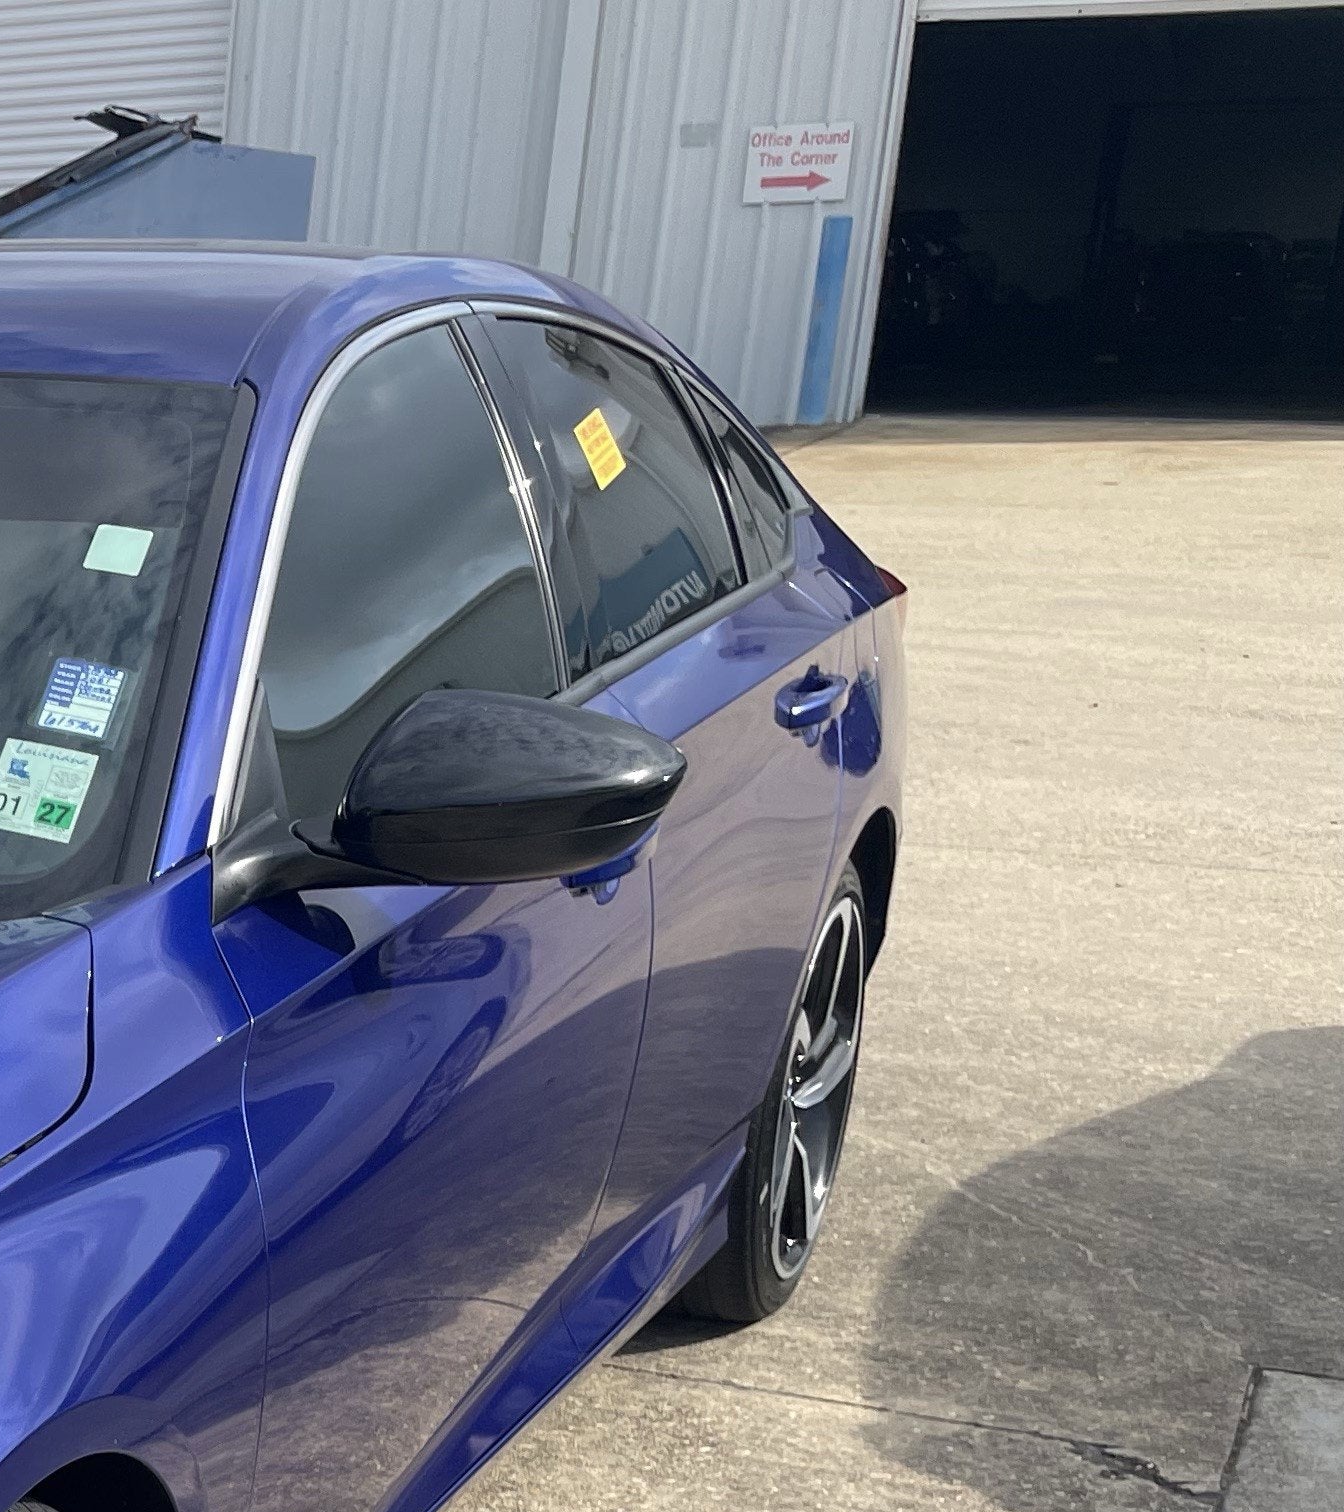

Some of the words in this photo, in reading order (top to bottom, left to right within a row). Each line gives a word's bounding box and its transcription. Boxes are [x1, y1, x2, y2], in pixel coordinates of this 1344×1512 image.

[751, 131, 793, 148] Office
[800, 129, 851, 146] Around
[758, 152, 784, 167] The
[790, 150, 838, 166] Corner
[16, 741, 89, 766] Louisiana
[37, 802, 72, 825] 27
